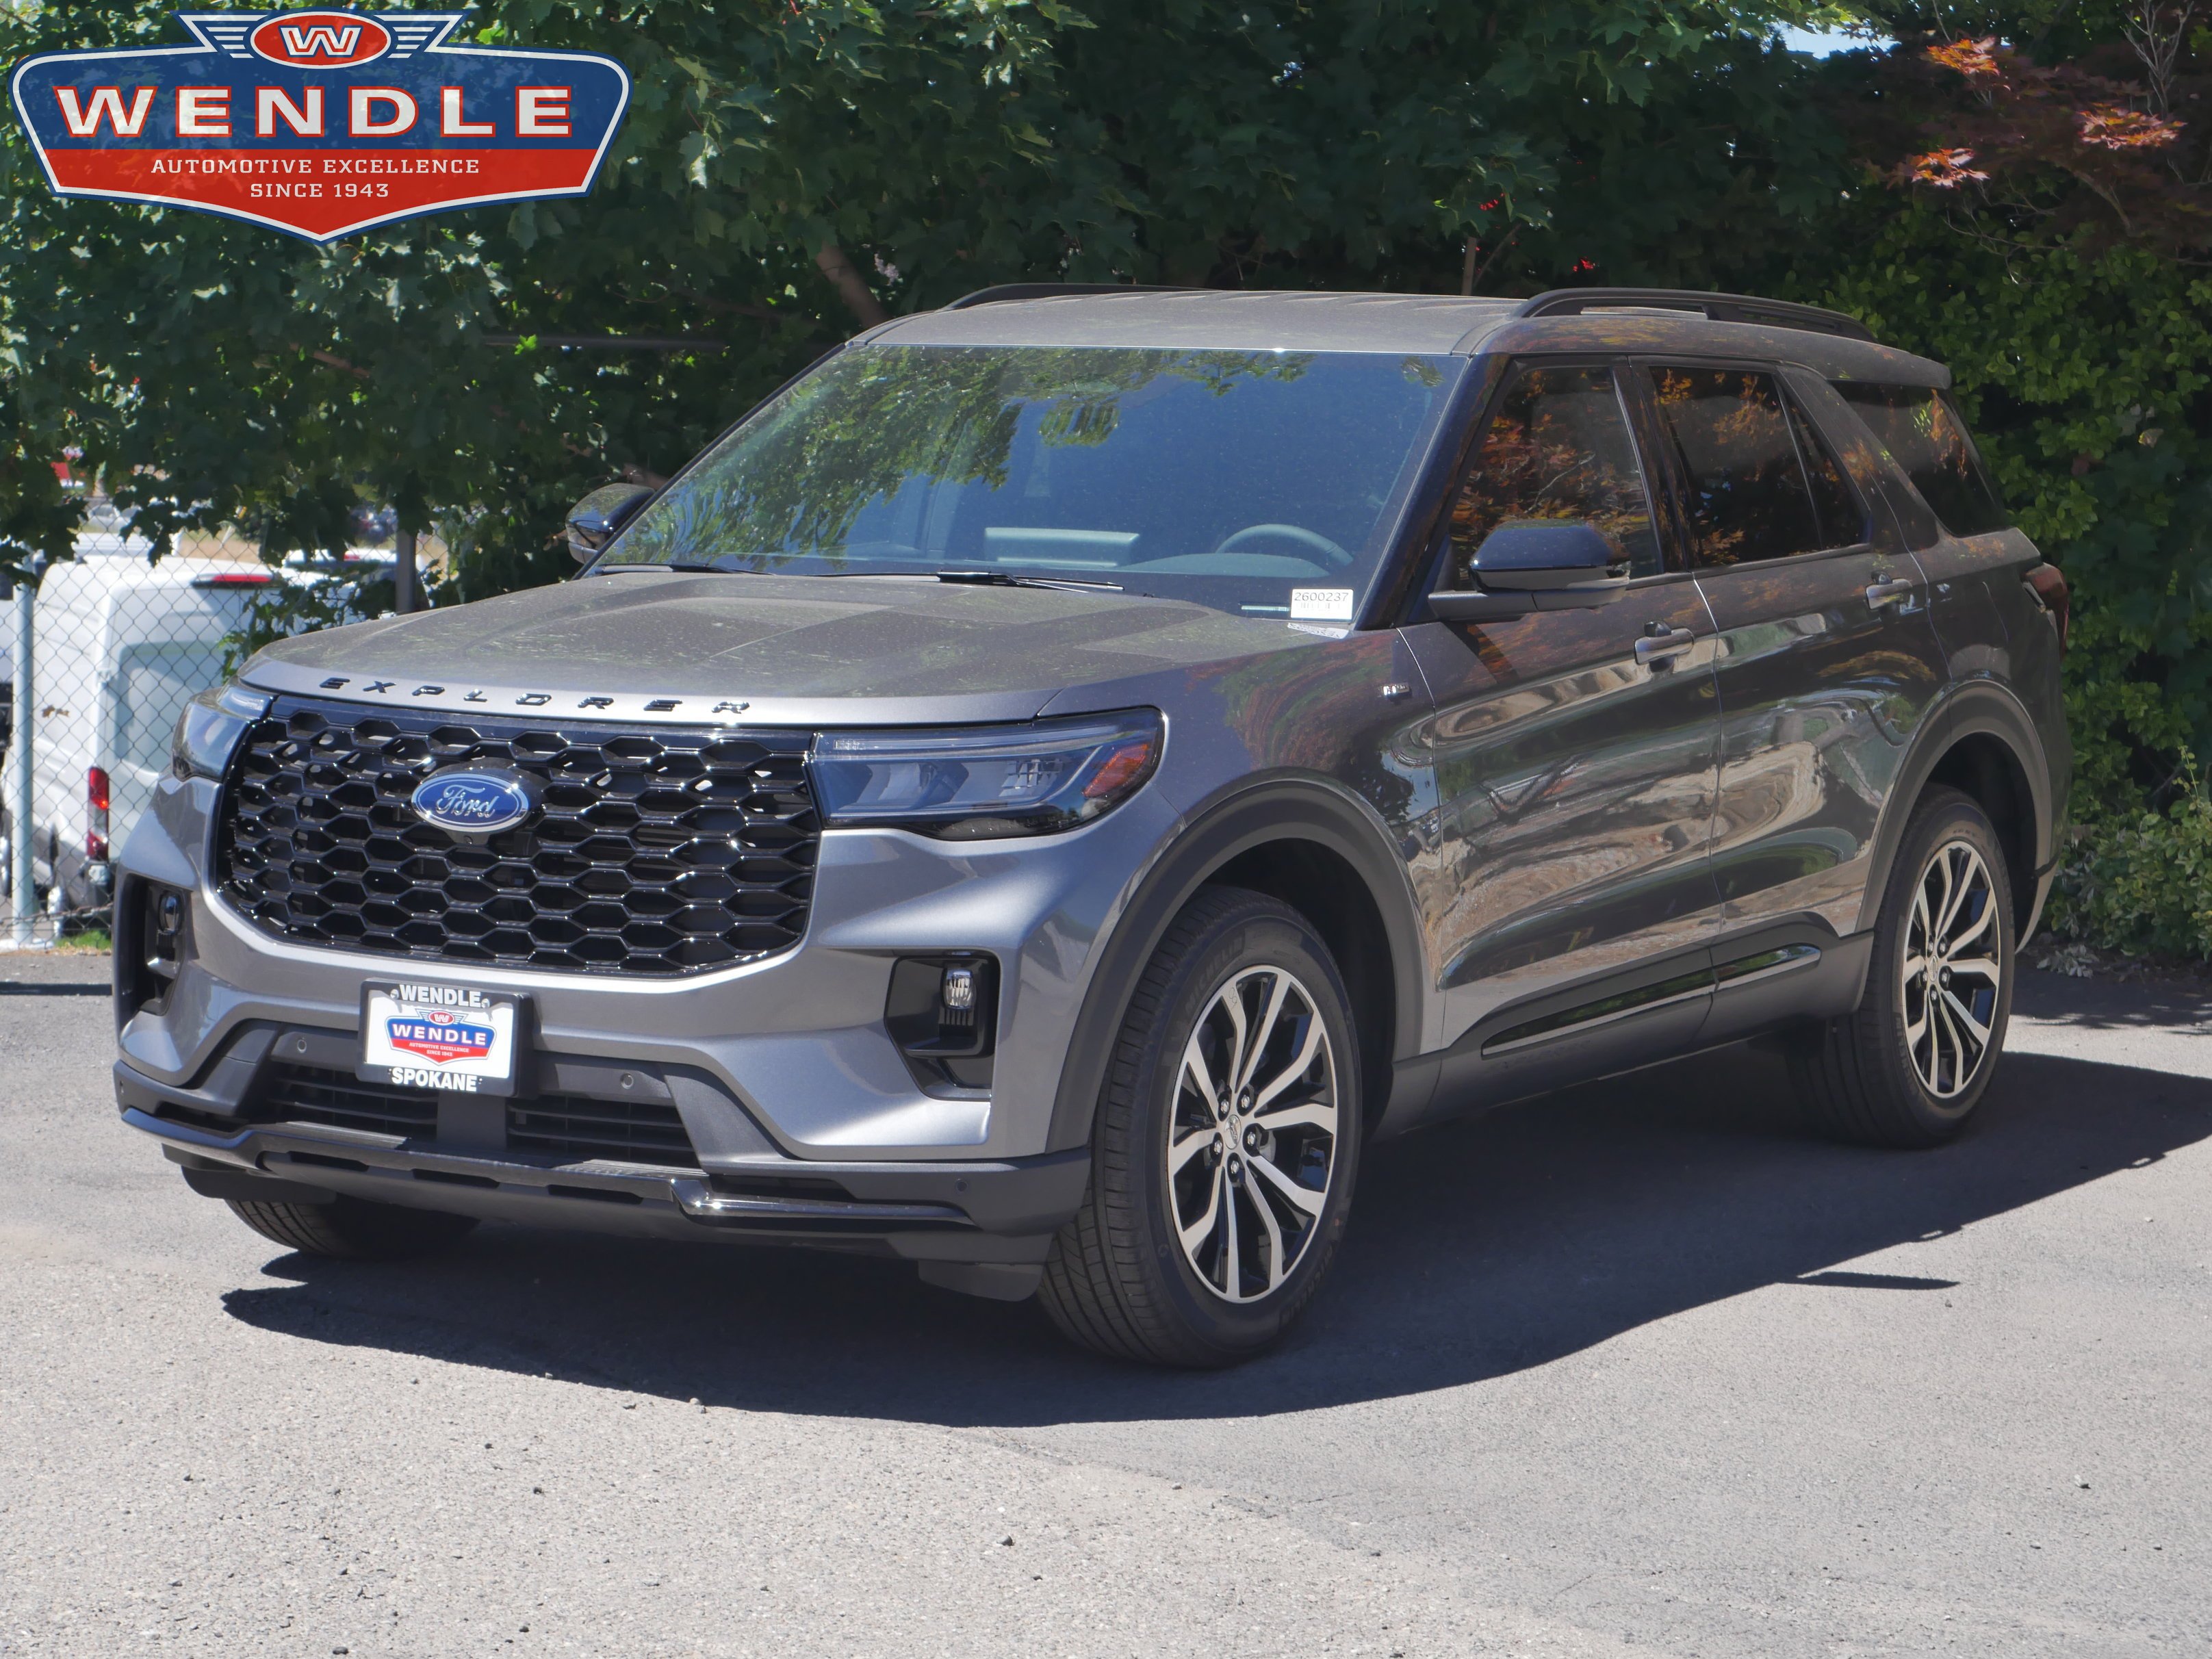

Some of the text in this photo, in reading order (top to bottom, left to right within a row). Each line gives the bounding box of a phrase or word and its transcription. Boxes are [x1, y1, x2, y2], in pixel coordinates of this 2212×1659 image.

[1294, 592, 1349, 602] 2600237
[319, 676, 750, 715] EXPLORER
[435, 784, 500, 818] Ford
[399, 984, 481, 1008] WENDLE
[433, 1014, 450, 1023] W
[391, 1023, 486, 1046] WENDLE
[409, 1042, 470, 1053] AUTOMOTIVE EXCELLENCE
[391, 1067, 477, 1092] SPOKANE
